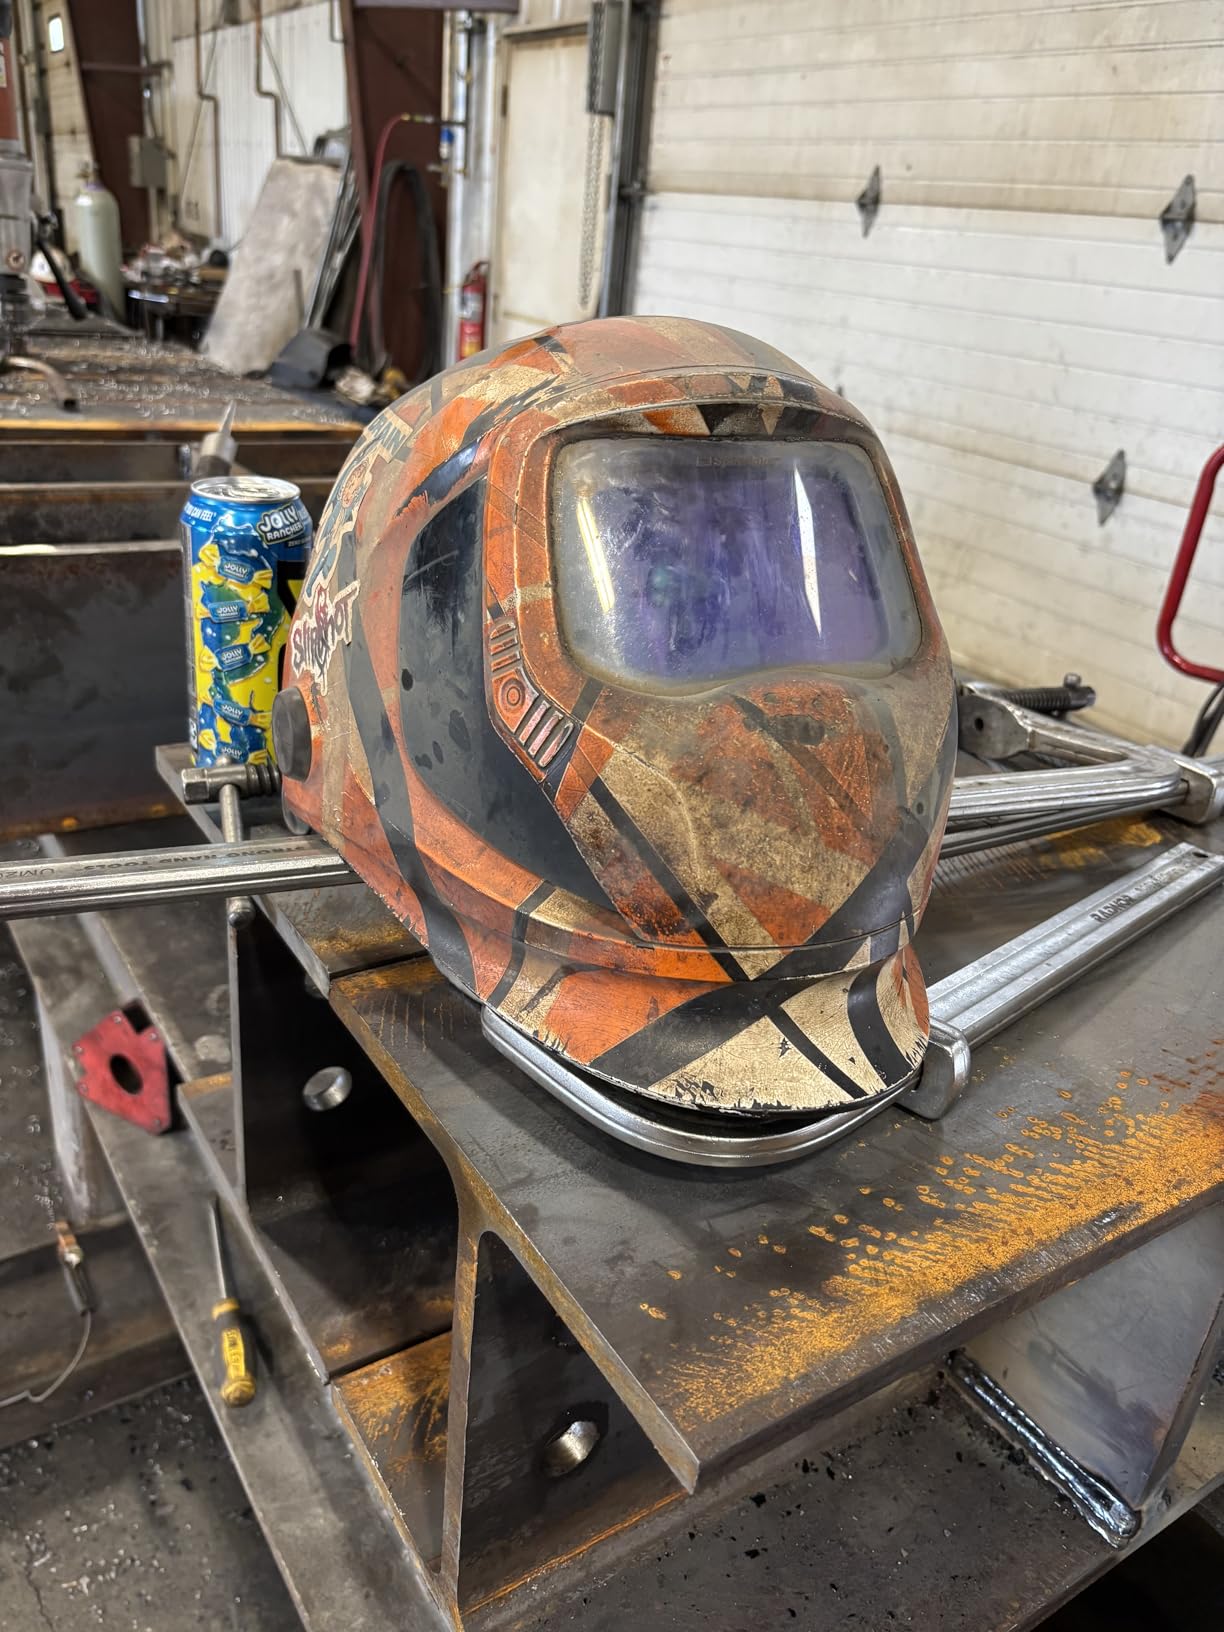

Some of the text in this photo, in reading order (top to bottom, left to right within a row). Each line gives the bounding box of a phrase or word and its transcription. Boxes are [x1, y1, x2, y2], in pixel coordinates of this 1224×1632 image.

[200, 509, 213, 522] FEEL
[260, 505, 298, 532] JOLLY
[266, 522, 302, 541] RANCHER
[224, 562, 248, 575] JOLLY
[217, 605, 238, 614] JOLLY
[221, 649, 242, 661] JOLLY
[222, 704, 243, 716] JOLLY
[225, 846, 304, 858] STRONG
[159, 854, 217, 863] HAND
[83, 861, 149, 870] TOOLS
[1089, 895, 1133, 923] RADNOR
